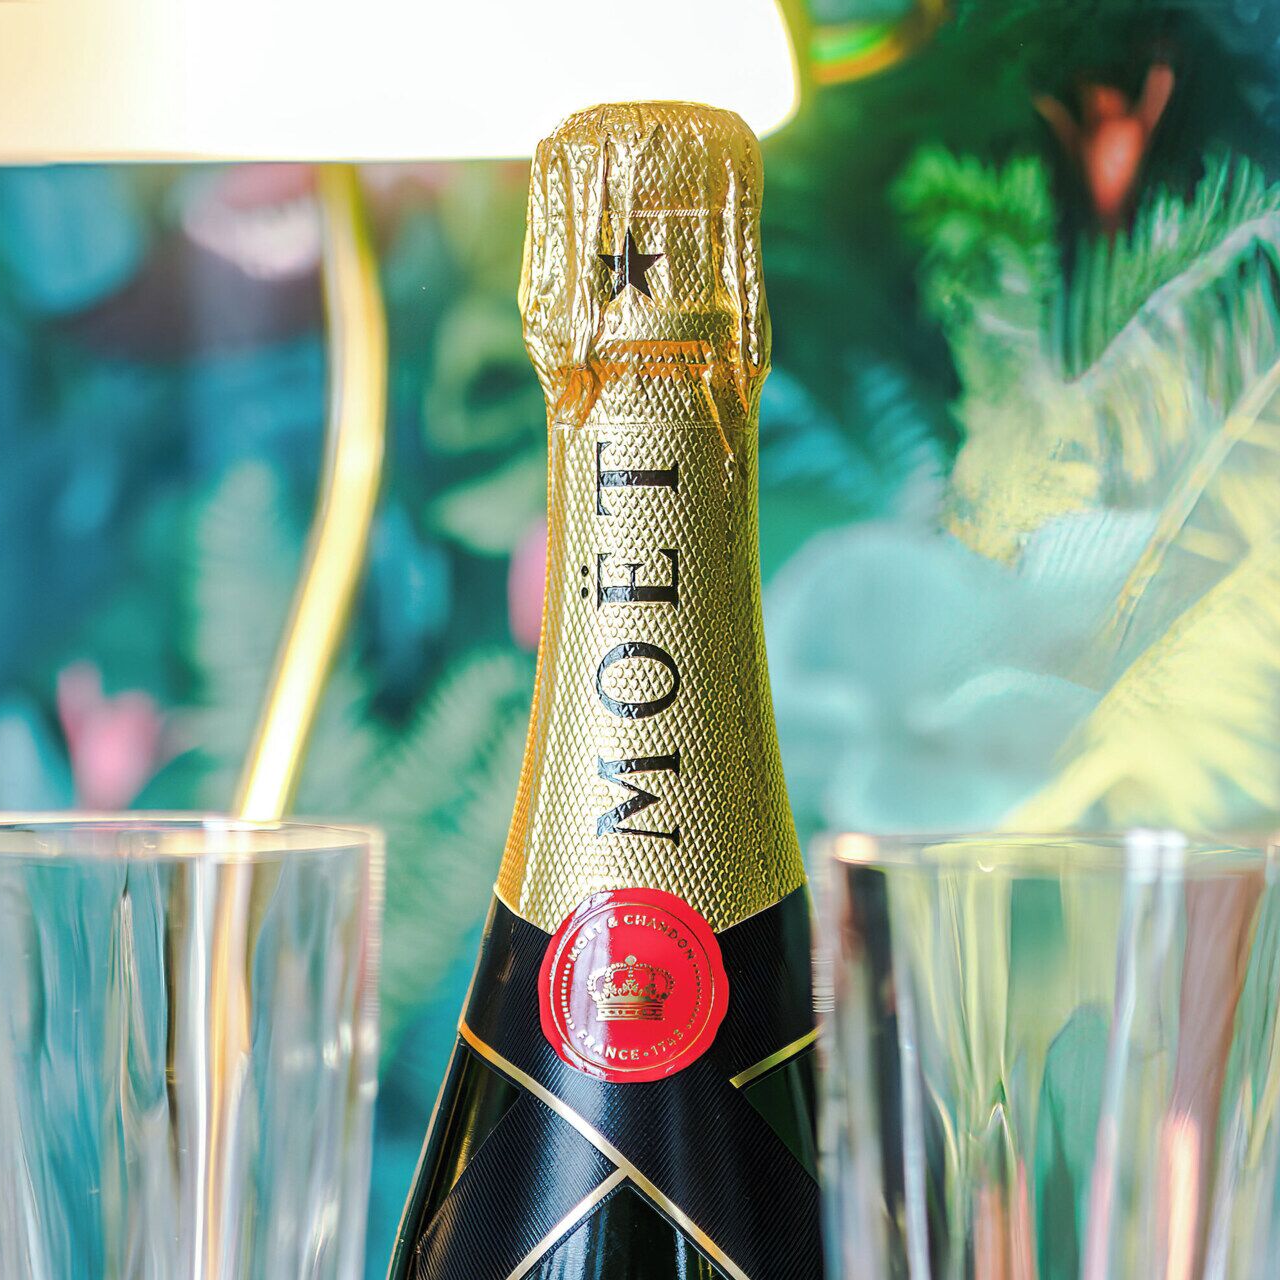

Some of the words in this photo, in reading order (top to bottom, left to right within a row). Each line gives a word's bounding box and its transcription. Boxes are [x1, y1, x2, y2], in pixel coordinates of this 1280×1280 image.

[581, 440, 681, 847] MOËT
[607, 916, 619, 929] &
[623, 914, 696, 960] CHANDON
[576, 1029, 640, 1061] FRANCE
